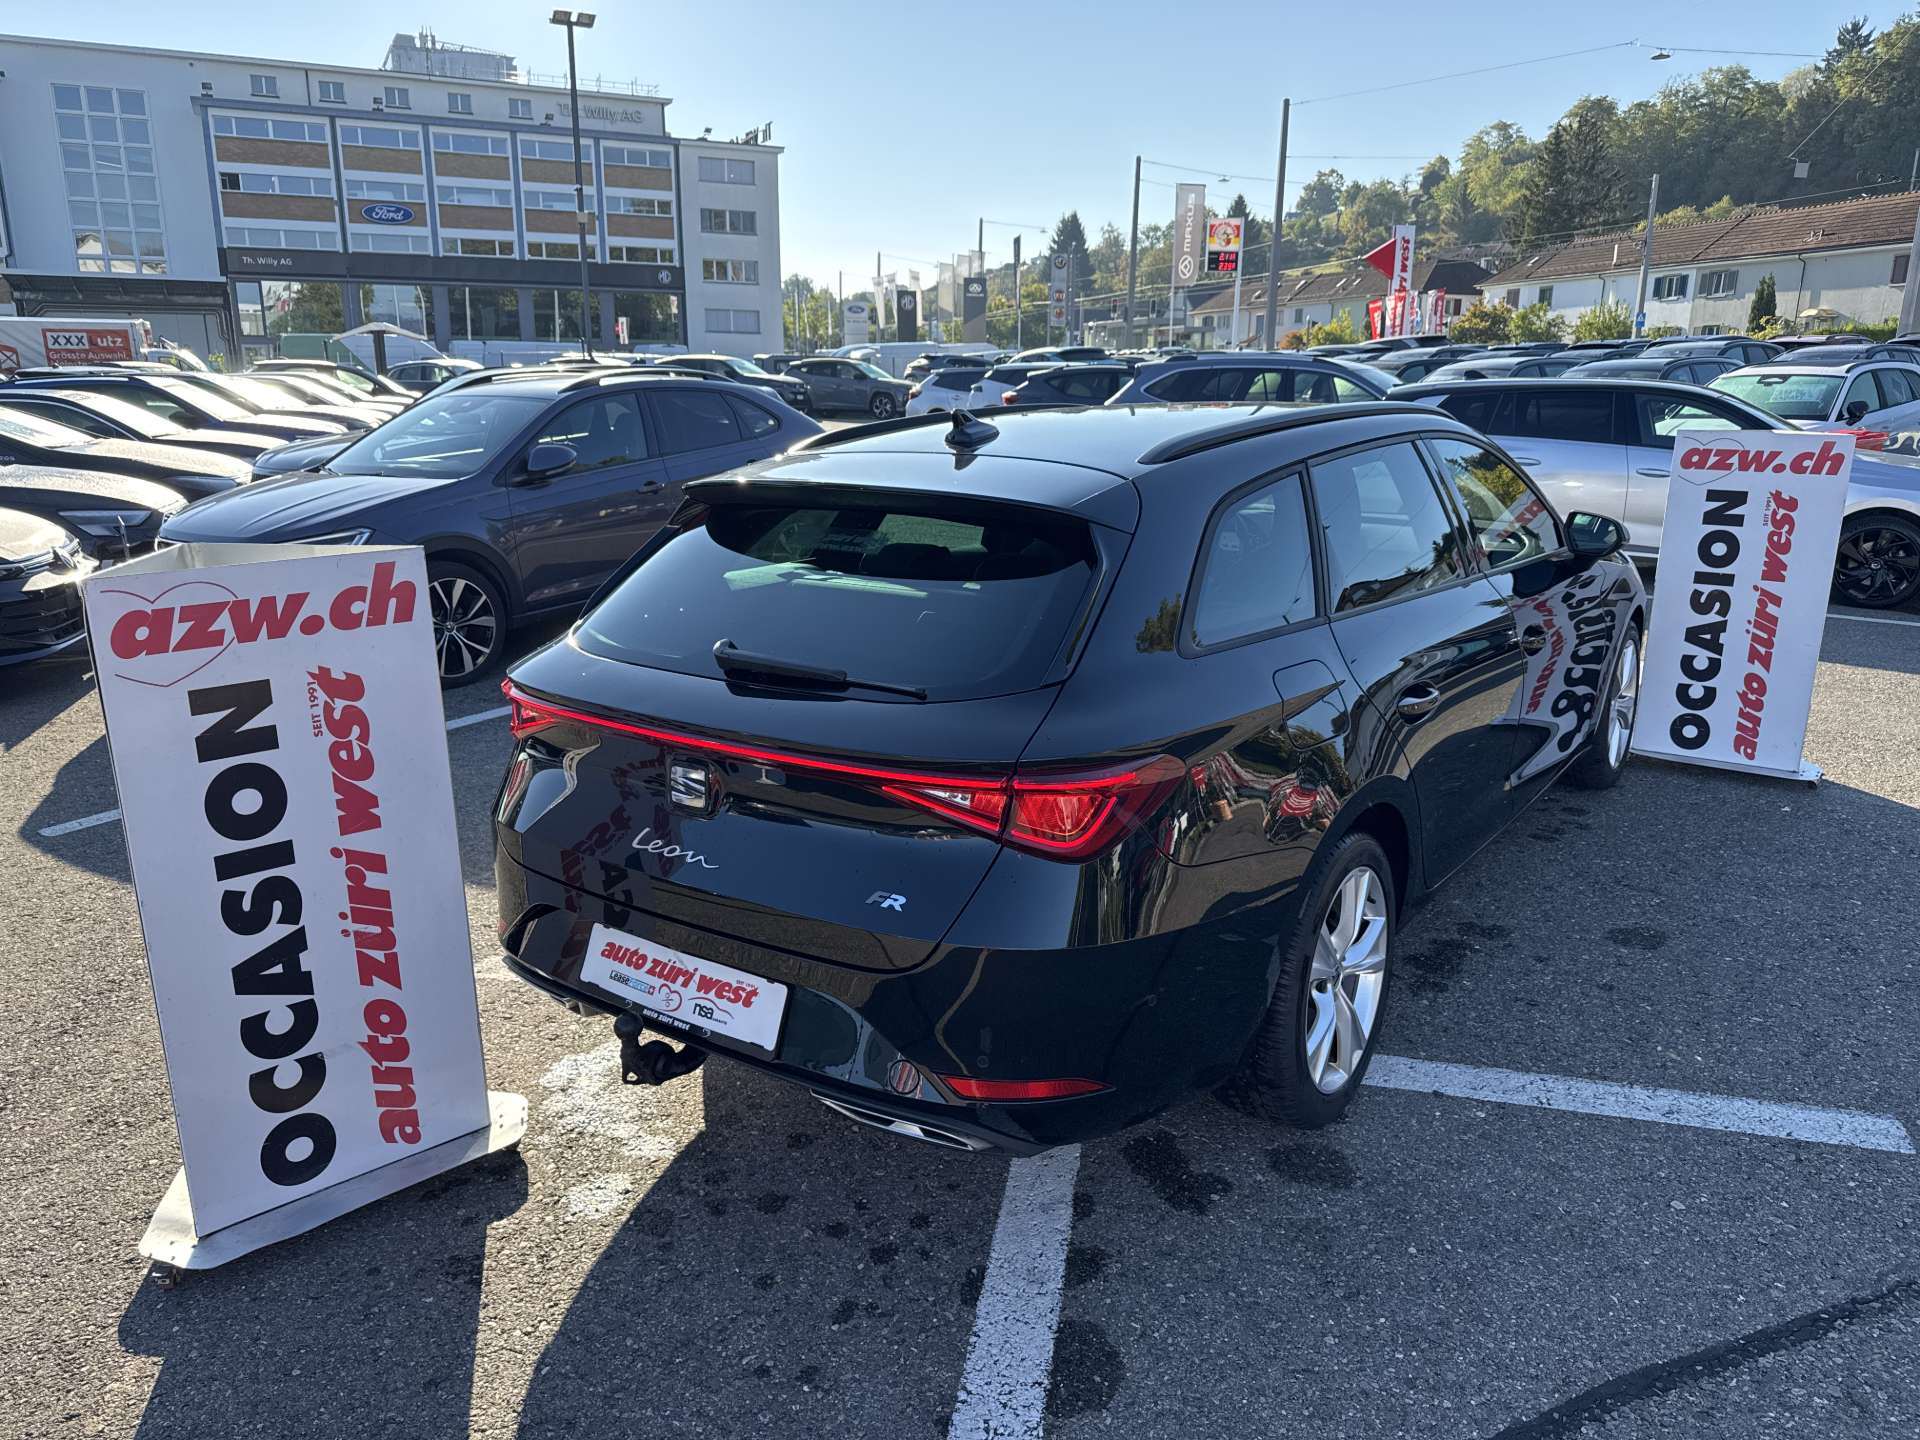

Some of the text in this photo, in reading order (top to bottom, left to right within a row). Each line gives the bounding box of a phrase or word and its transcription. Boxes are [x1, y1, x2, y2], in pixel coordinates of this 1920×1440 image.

[583, 104, 616, 125] Willy
[620, 109, 642, 123] AG
[257, 257, 277, 267] Willy
[280, 258, 292, 266] AG
[1679, 441, 1846, 475] azw.ch
[111, 563, 416, 660] azw.ch
[1669, 489, 1749, 750] OCCASION
[1733, 489, 1799, 761] auto züri west
[307, 681, 324, 737] SEIT 1991
[632, 827, 720, 869] Leon
[306, 664, 422, 1146] auto züri west
[865, 890, 907, 912] FR
[188, 678, 337, 1187] OCCASION
[601, 941, 648, 970] auto
[645, 959, 699, 989] züri
[696, 974, 759, 1009] west
[642, 1008, 658, 1019] auto
[673, 1019, 690, 1031] west
